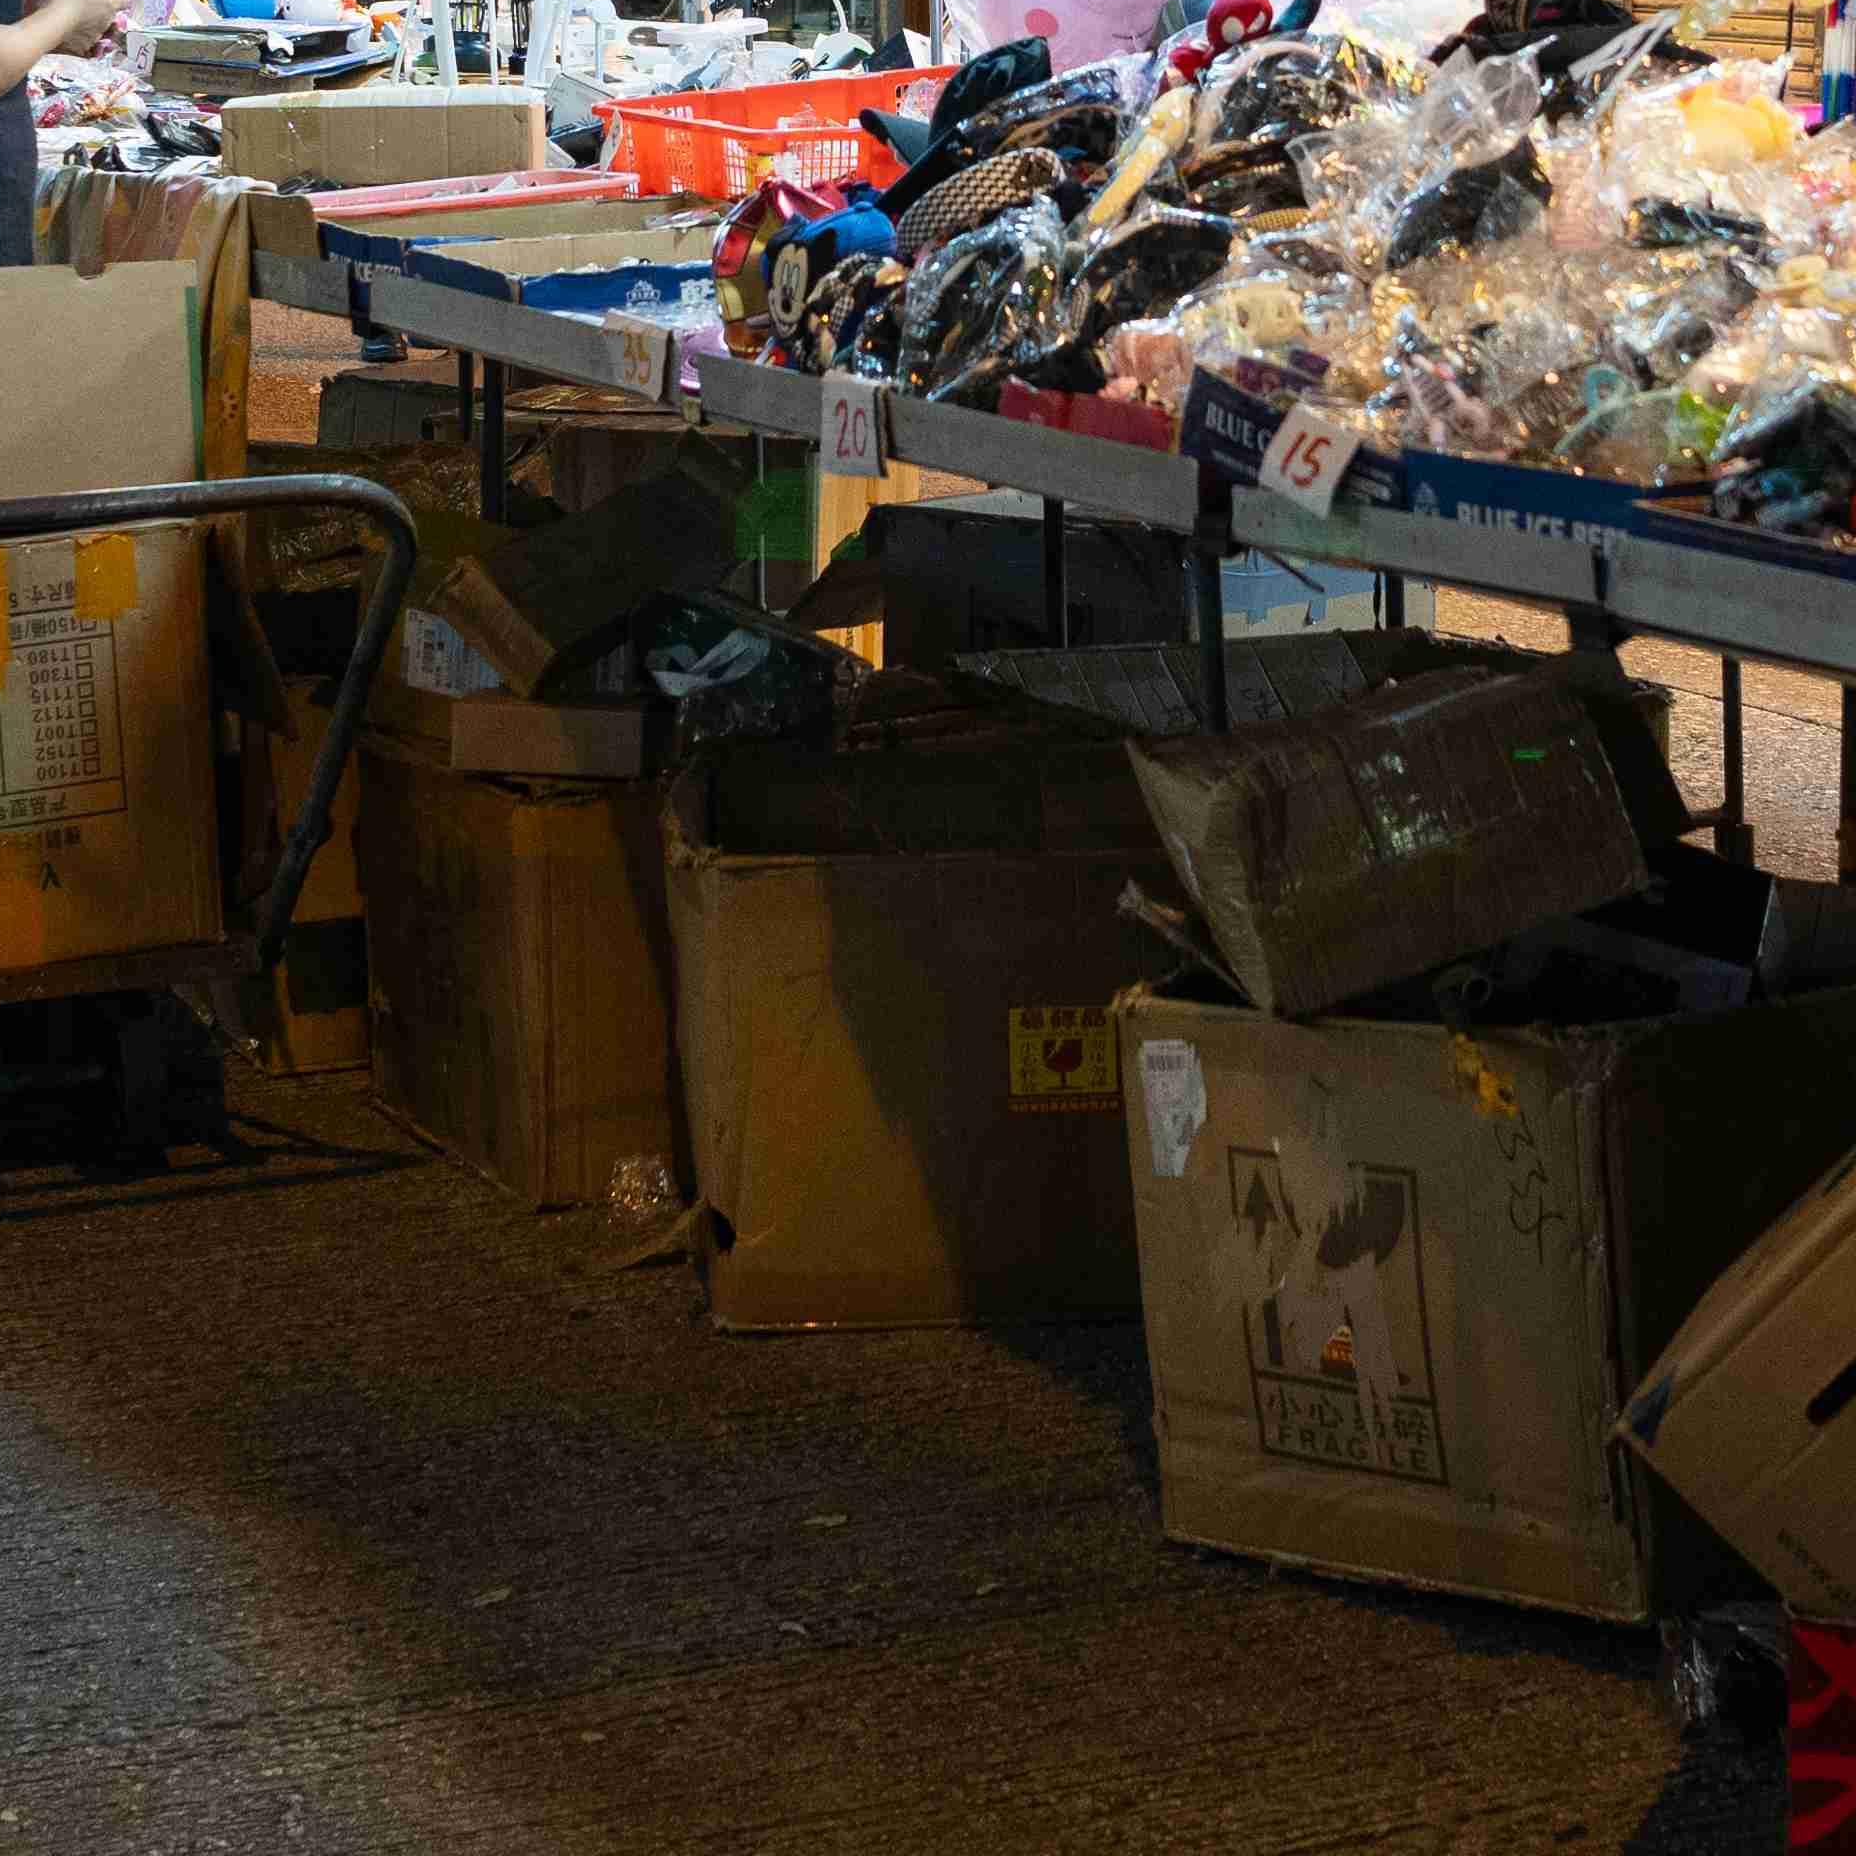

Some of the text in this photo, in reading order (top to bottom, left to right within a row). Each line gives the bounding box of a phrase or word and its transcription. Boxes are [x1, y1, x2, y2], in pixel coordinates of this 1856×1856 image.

[834, 398, 867, 459] 20
[1205, 401, 1254, 443] BLUE
[1280, 430, 1332, 488] 15
[1454, 501, 1519, 532] BLUE
[29, 667, 71, 684] T300
[31, 686, 73, 704] T115
[32, 705, 76, 723] T112
[34, 725, 78, 742] T007
[35, 763, 81, 781] T100
